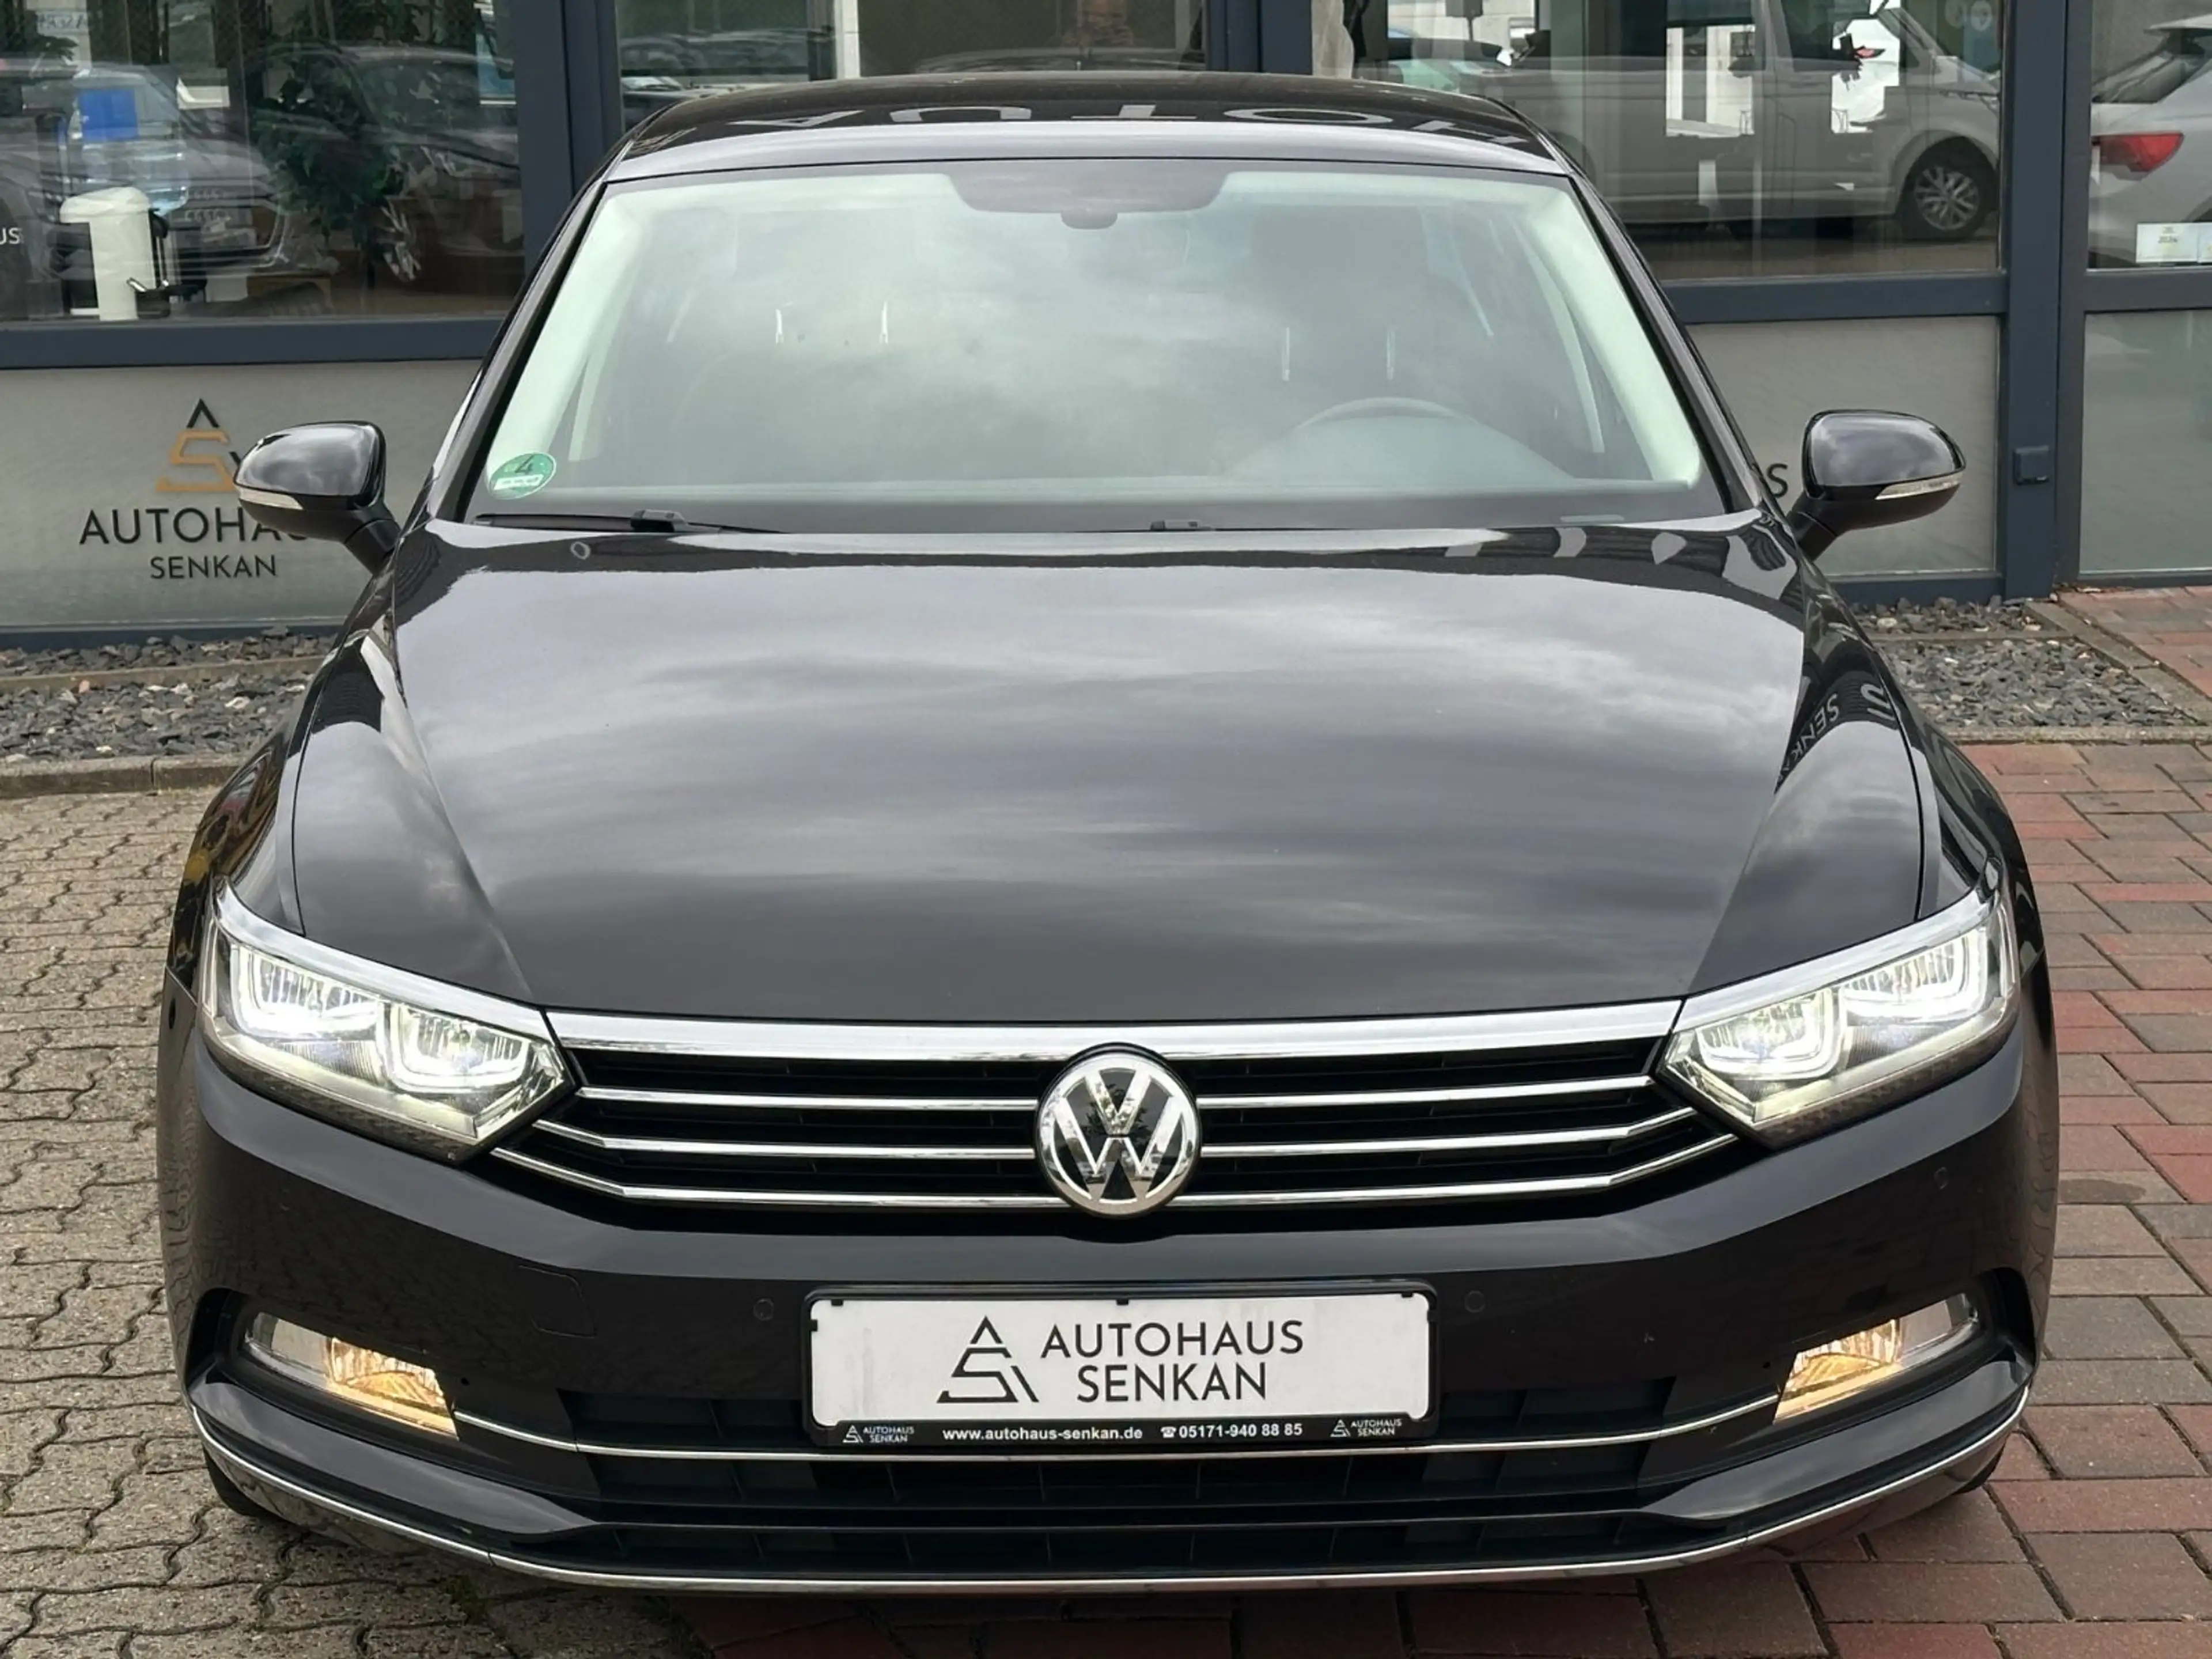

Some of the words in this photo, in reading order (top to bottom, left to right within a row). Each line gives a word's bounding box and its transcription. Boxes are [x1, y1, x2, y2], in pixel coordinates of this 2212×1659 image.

[79, 507, 307, 545] AUTOHA
[150, 555, 278, 579] SENKAN
[1040, 1320, 1304, 1359] AUTOHAUS
[1077, 1361, 1267, 1403] SENKAN
[863, 1426, 915, 1434] AUTOHAUS
[1179, 1423, 1257, 1438] 05171-940
[1261, 1423, 1280, 1437] 88
[1284, 1422, 1303, 1436] 85
[1351, 1418, 1403, 1428] AUTOHAUS
[869, 1434, 908, 1444] SENKAN
[942, 1426, 1143, 1441] www.autohaus-senkan.de
[1357, 1427, 1396, 1437] SENKAN
